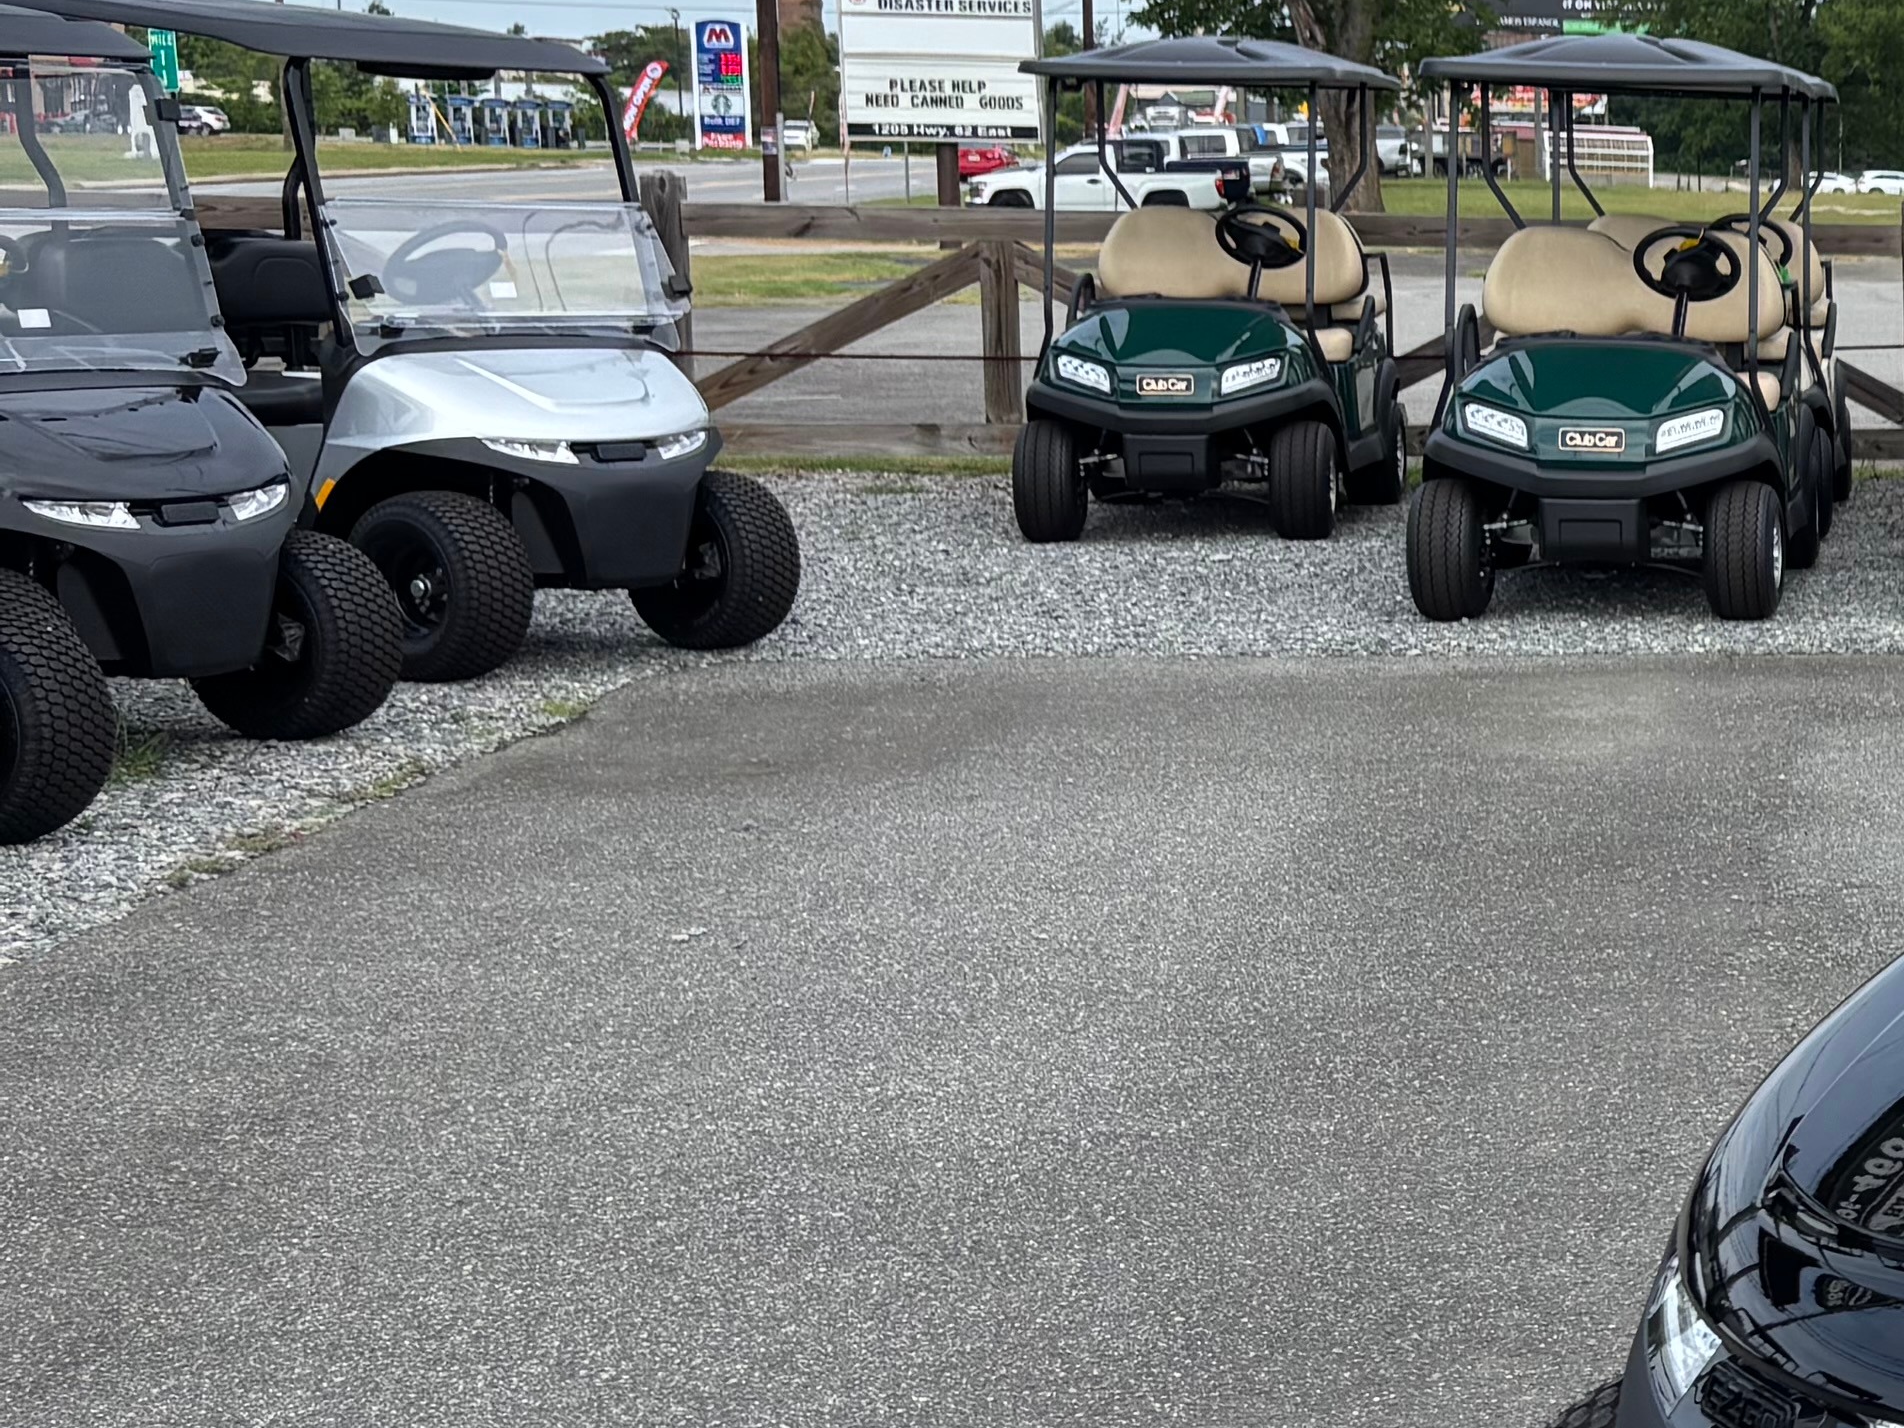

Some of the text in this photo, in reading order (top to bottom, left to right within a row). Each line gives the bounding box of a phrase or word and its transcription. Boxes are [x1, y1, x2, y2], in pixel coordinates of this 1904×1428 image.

[958, 0, 1032, 14] SERVICES
[150, 33, 173, 46] MILE
[889, 78, 987, 94] PLEASE HELP
[865, 93, 1024, 110] NEED CANNED GOODS
[1142, 378, 1188, 391] Club Car
[1565, 431, 1619, 447] Club Car
